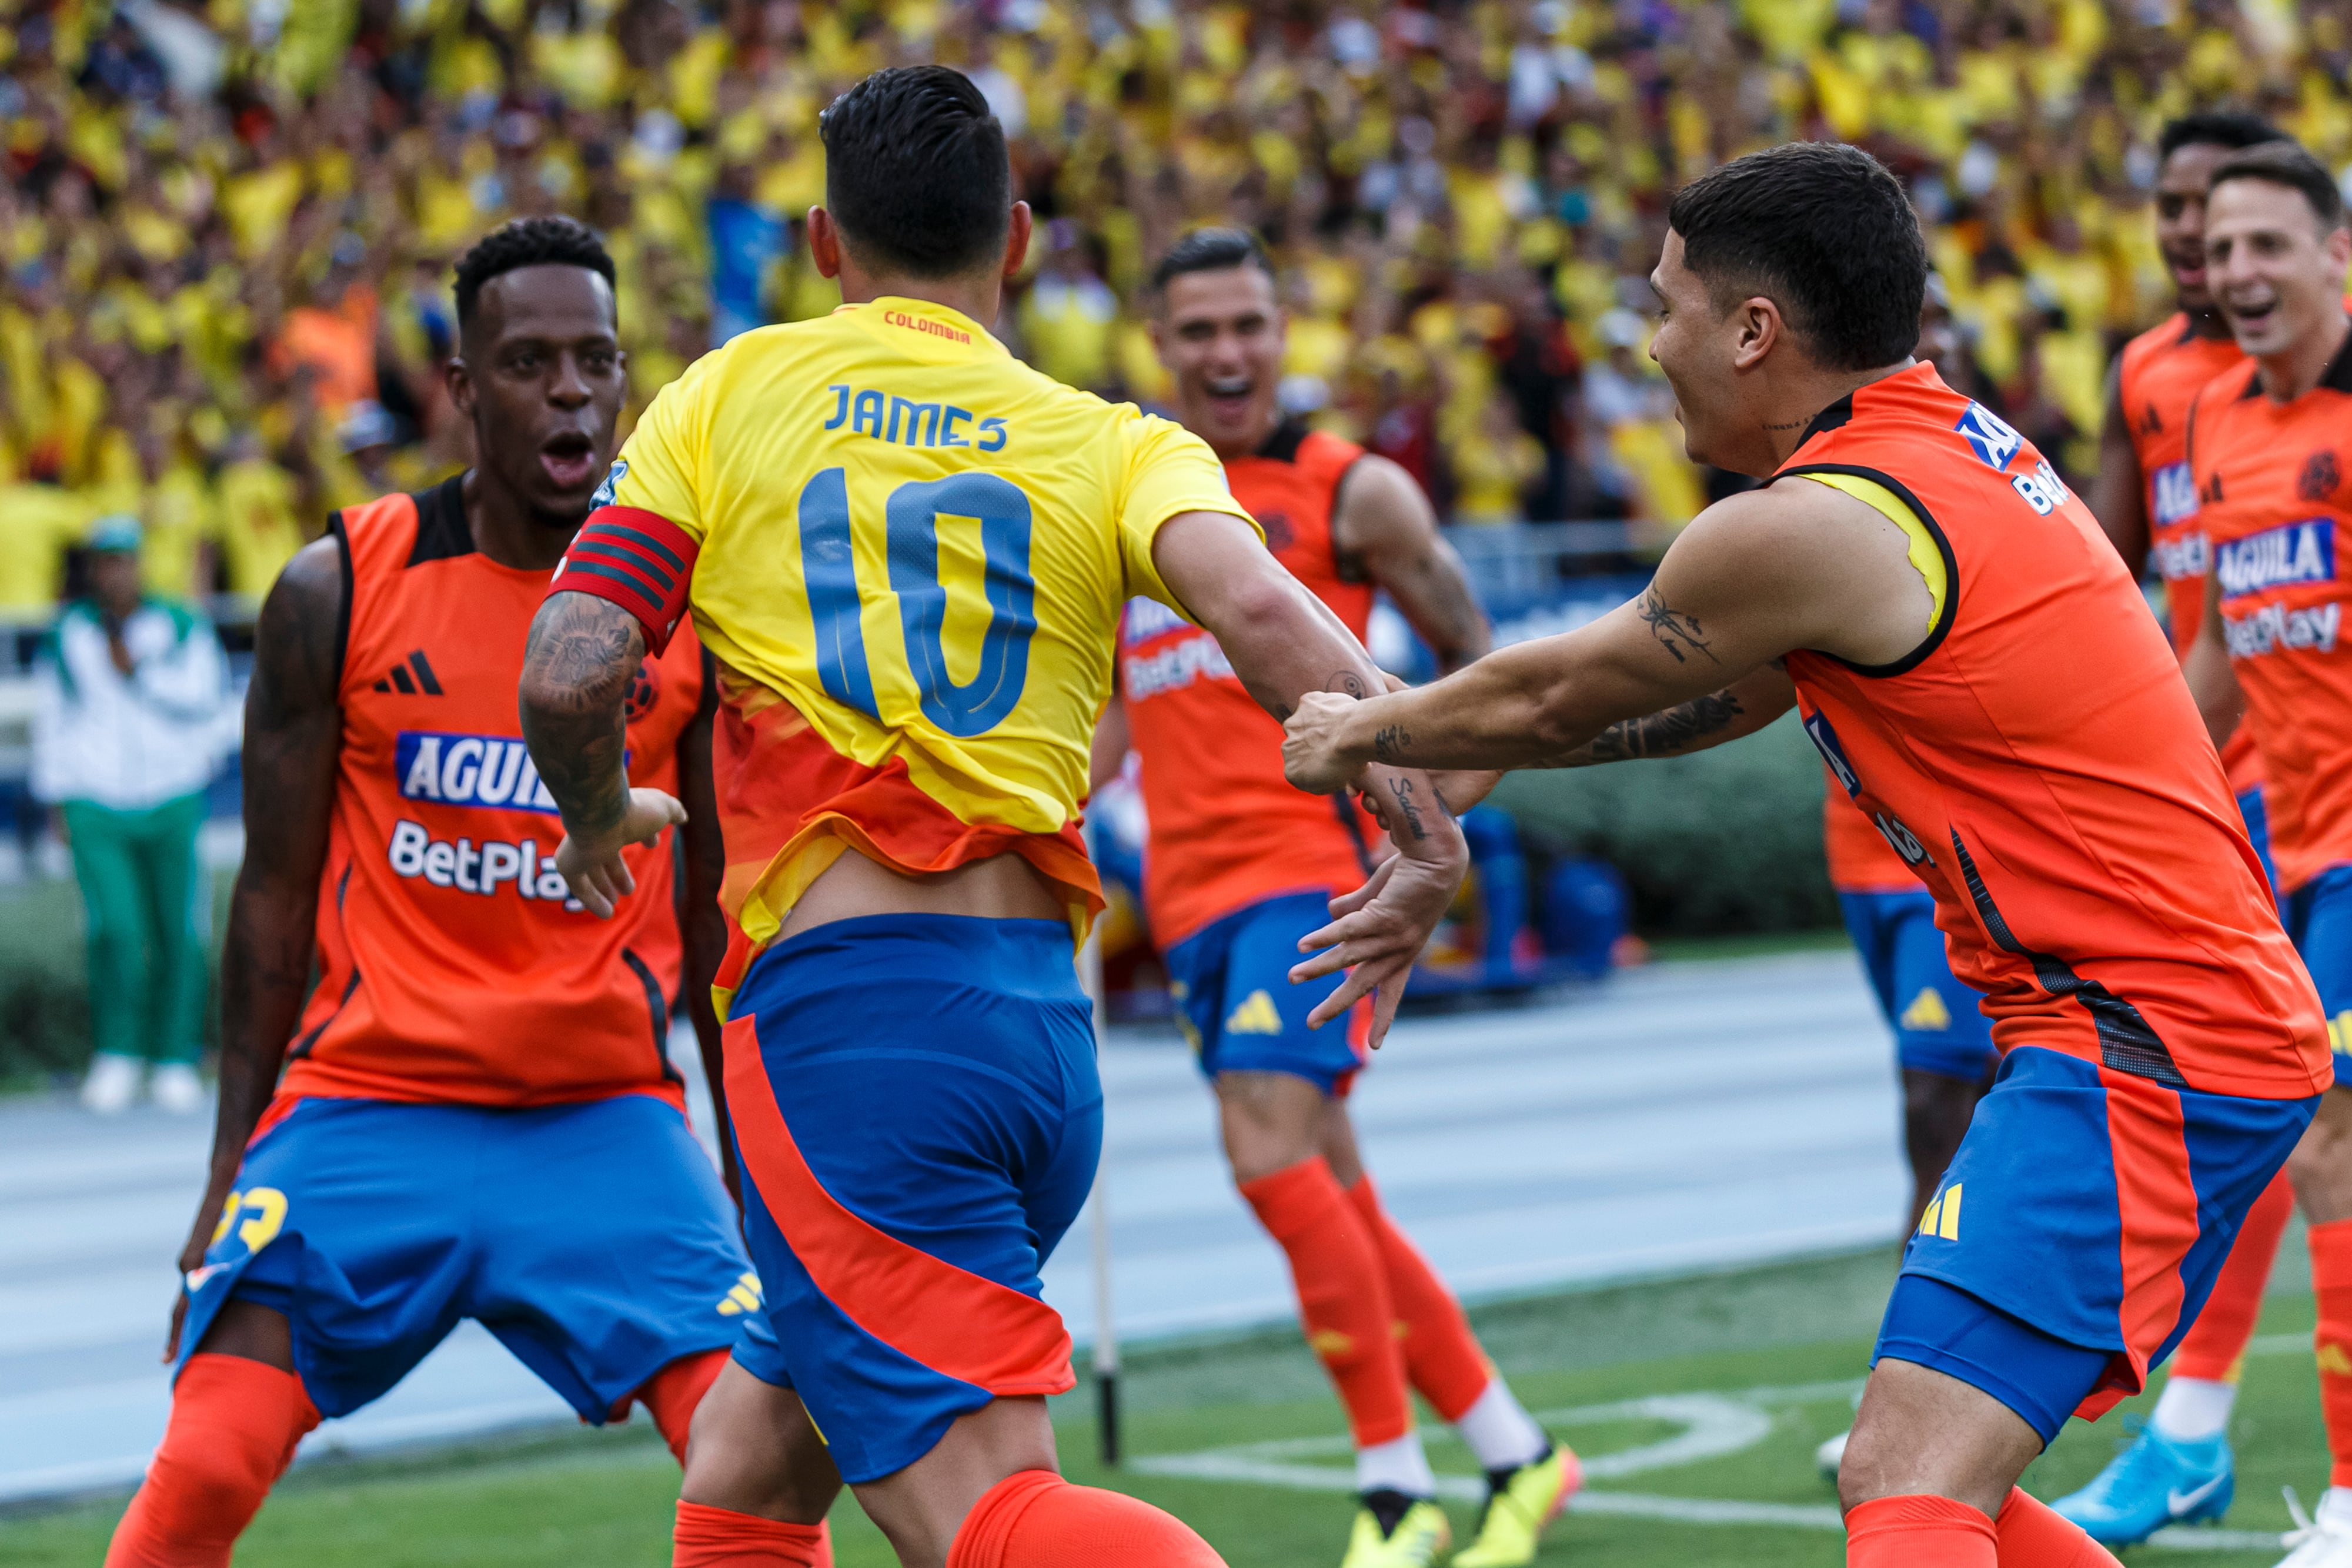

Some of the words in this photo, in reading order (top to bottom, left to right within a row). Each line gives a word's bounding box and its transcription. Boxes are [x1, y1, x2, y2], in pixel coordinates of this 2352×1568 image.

[884, 310, 971, 345] COLOMBIA
[825, 385, 1008, 452] JAMES
[798, 467, 1037, 738] 10
[389, 818, 587, 912] BetPla
